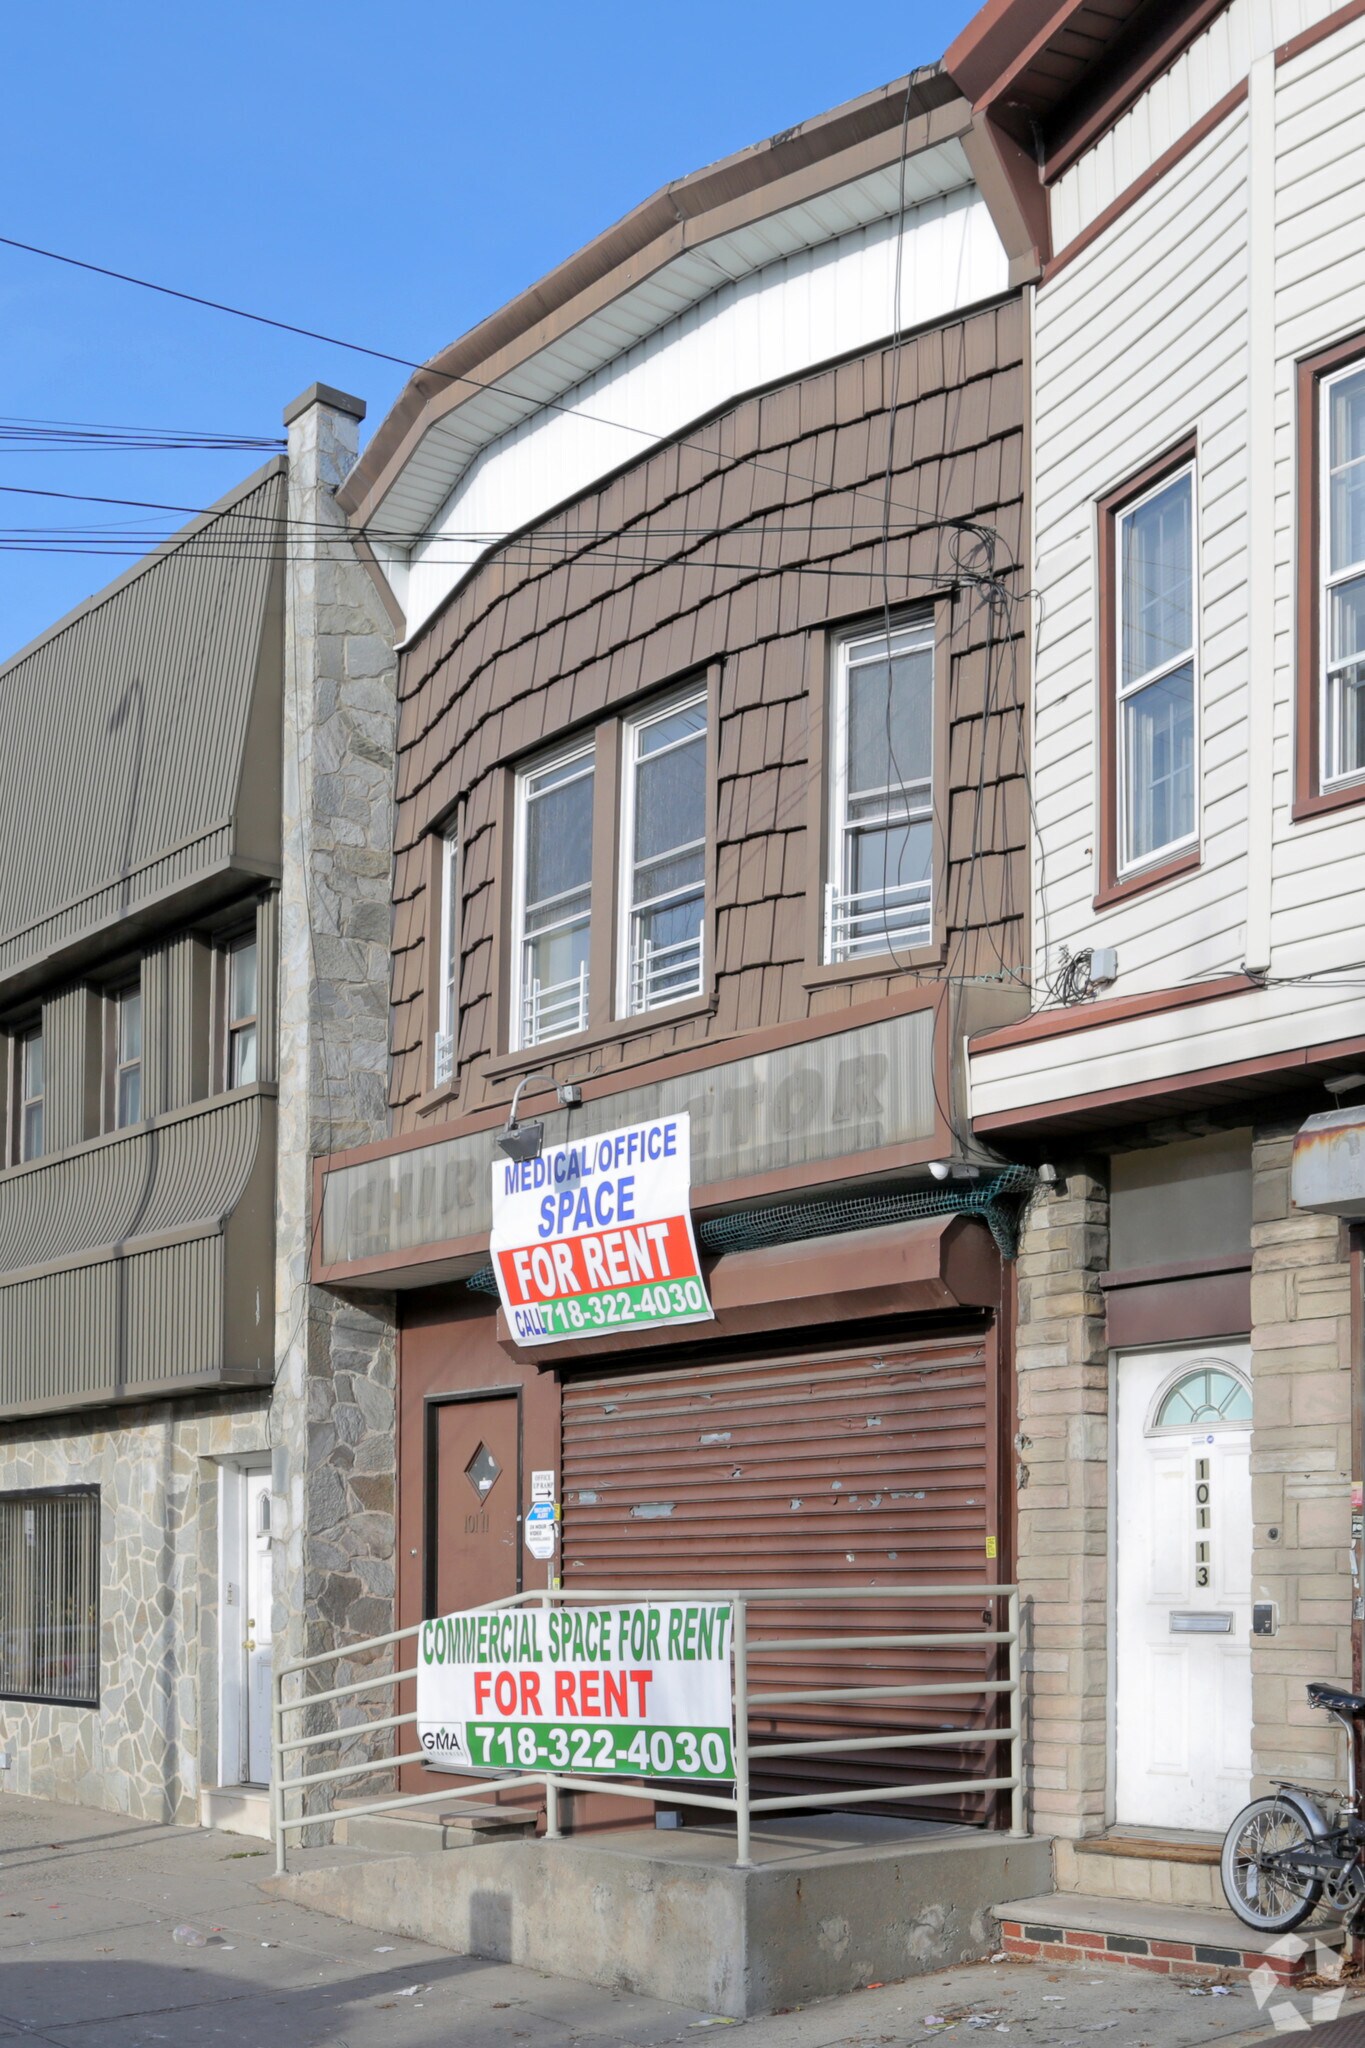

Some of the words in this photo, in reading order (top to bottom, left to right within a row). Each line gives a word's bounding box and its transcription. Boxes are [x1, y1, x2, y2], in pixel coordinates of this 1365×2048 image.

[505, 1122, 677, 1195] MEDICAL/OFFICE
[538, 1176, 635, 1238] SPACE
[513, 1243, 581, 1300] FOR
[581, 1222, 671, 1290] RENT
[515, 1303, 547, 1337] CALL
[541, 1280, 702, 1331] 718-322-4030
[423, 1614, 543, 1665] COMMERCIAL
[549, 1610, 611, 1663] SPACE
[618, 1608, 661, 1662] FOR
[668, 1606, 730, 1661] RENT
[474, 1670, 543, 1717] FOR
[555, 1670, 653, 1718] RENT
[422, 1731, 460, 1751] GMA
[474, 1726, 727, 1774] 718-322-4030
